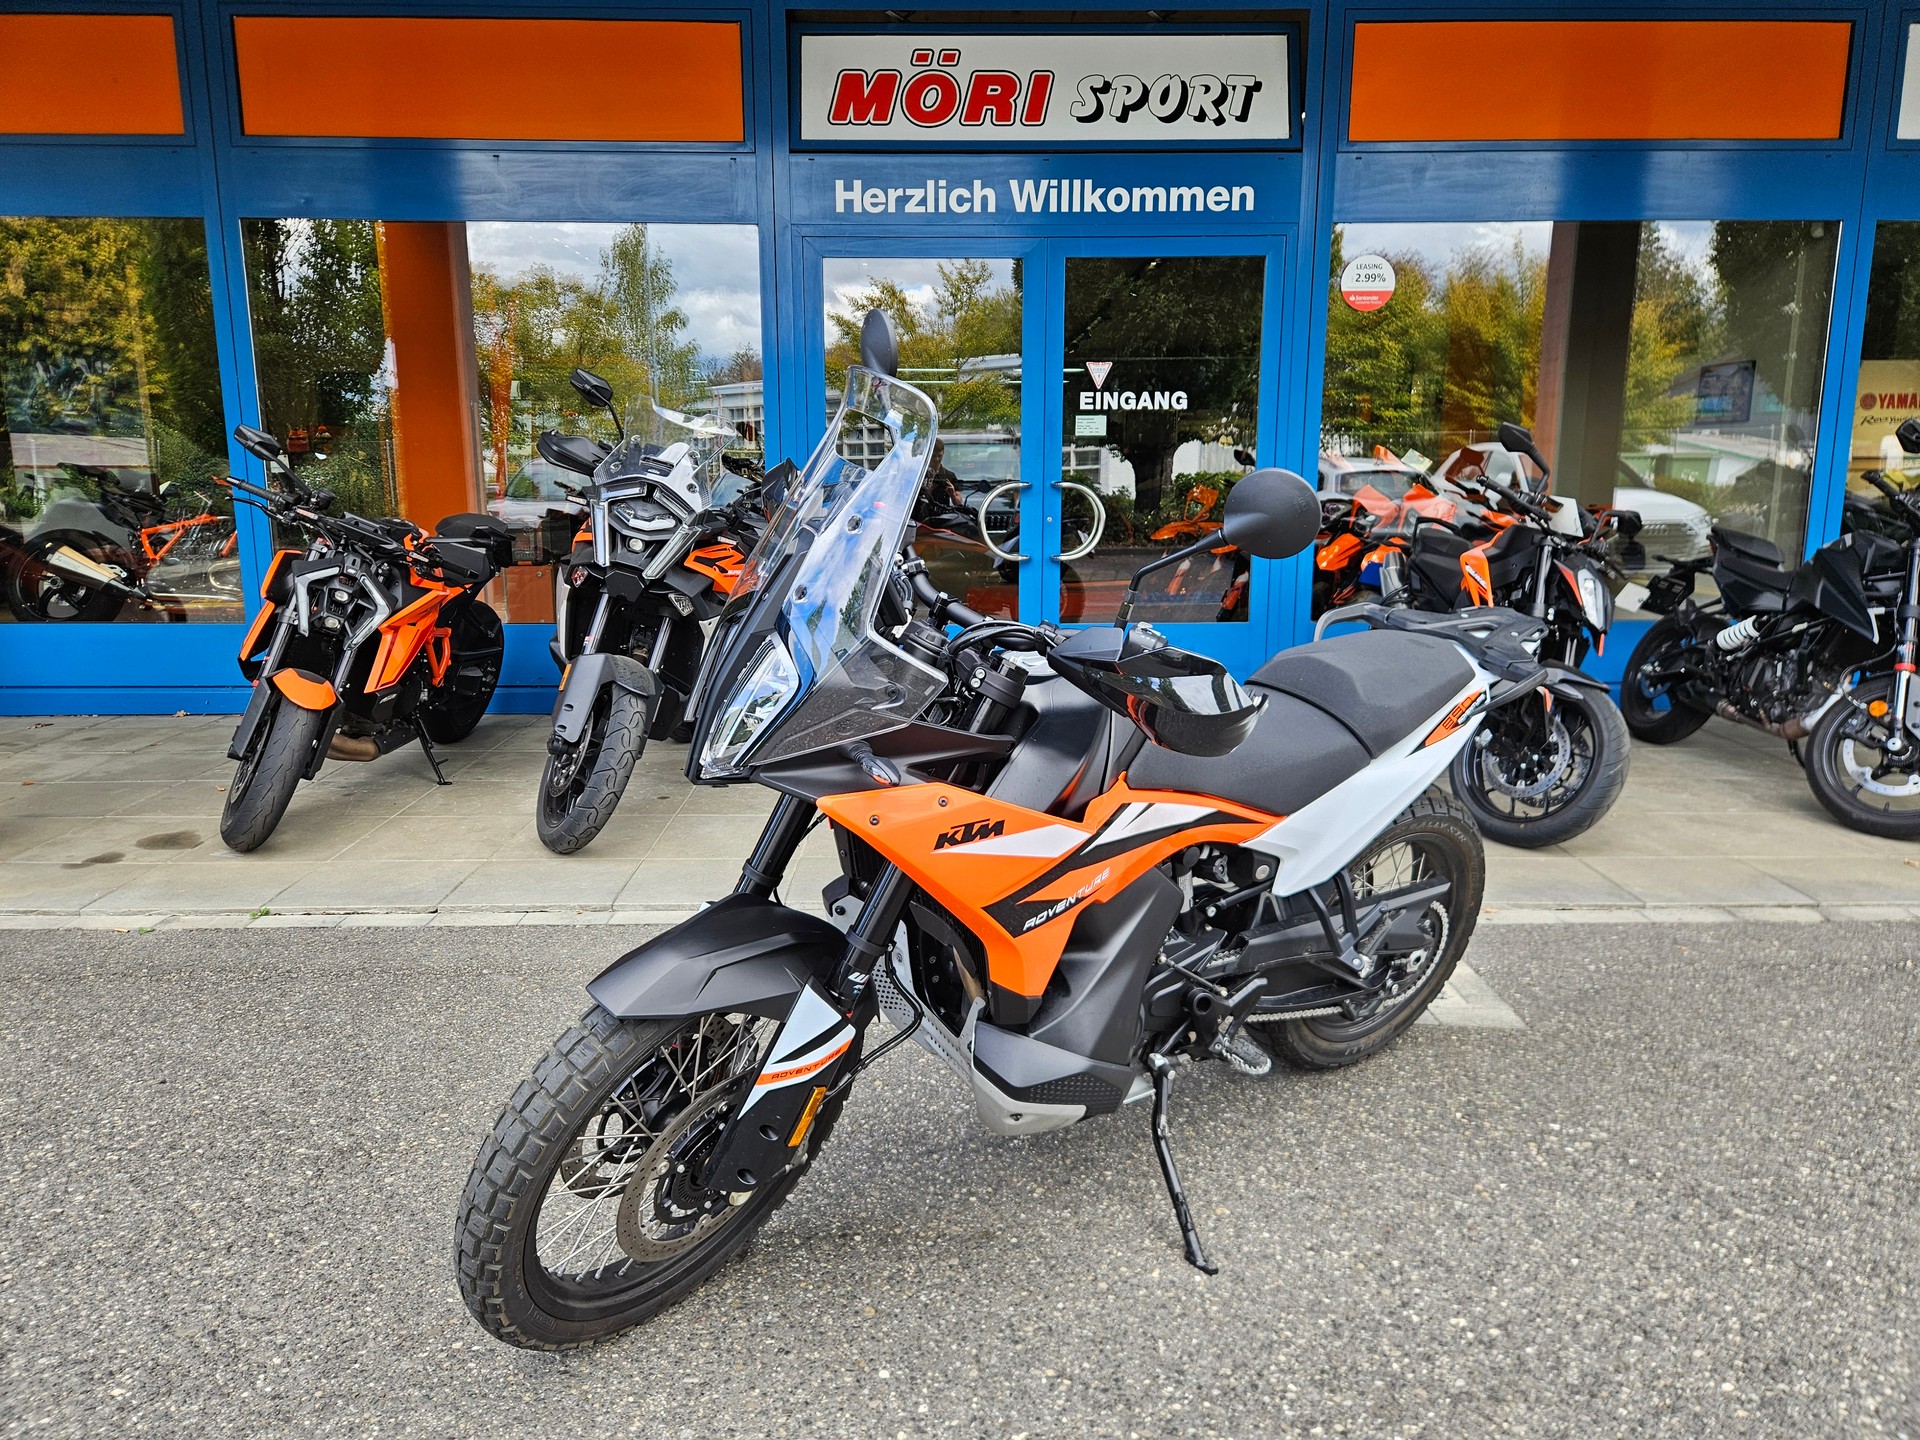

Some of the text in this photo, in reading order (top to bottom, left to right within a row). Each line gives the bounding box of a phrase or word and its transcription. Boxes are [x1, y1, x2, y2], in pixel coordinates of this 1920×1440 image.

[827, 48, 1263, 128] MÖRI SPORT
[835, 179, 1255, 214] Herzlich Willkommen
[1355, 273, 1386, 283] 2.99%
[1080, 391, 1188, 410] EINGANG
[1878, 392, 1920, 410] YAMA
[1442, 696, 1473, 730] 890
[933, 818, 1006, 850] KTM
[1022, 866, 1111, 932] ADVENTURE
[771, 1047, 842, 1081] ADVENTURE
